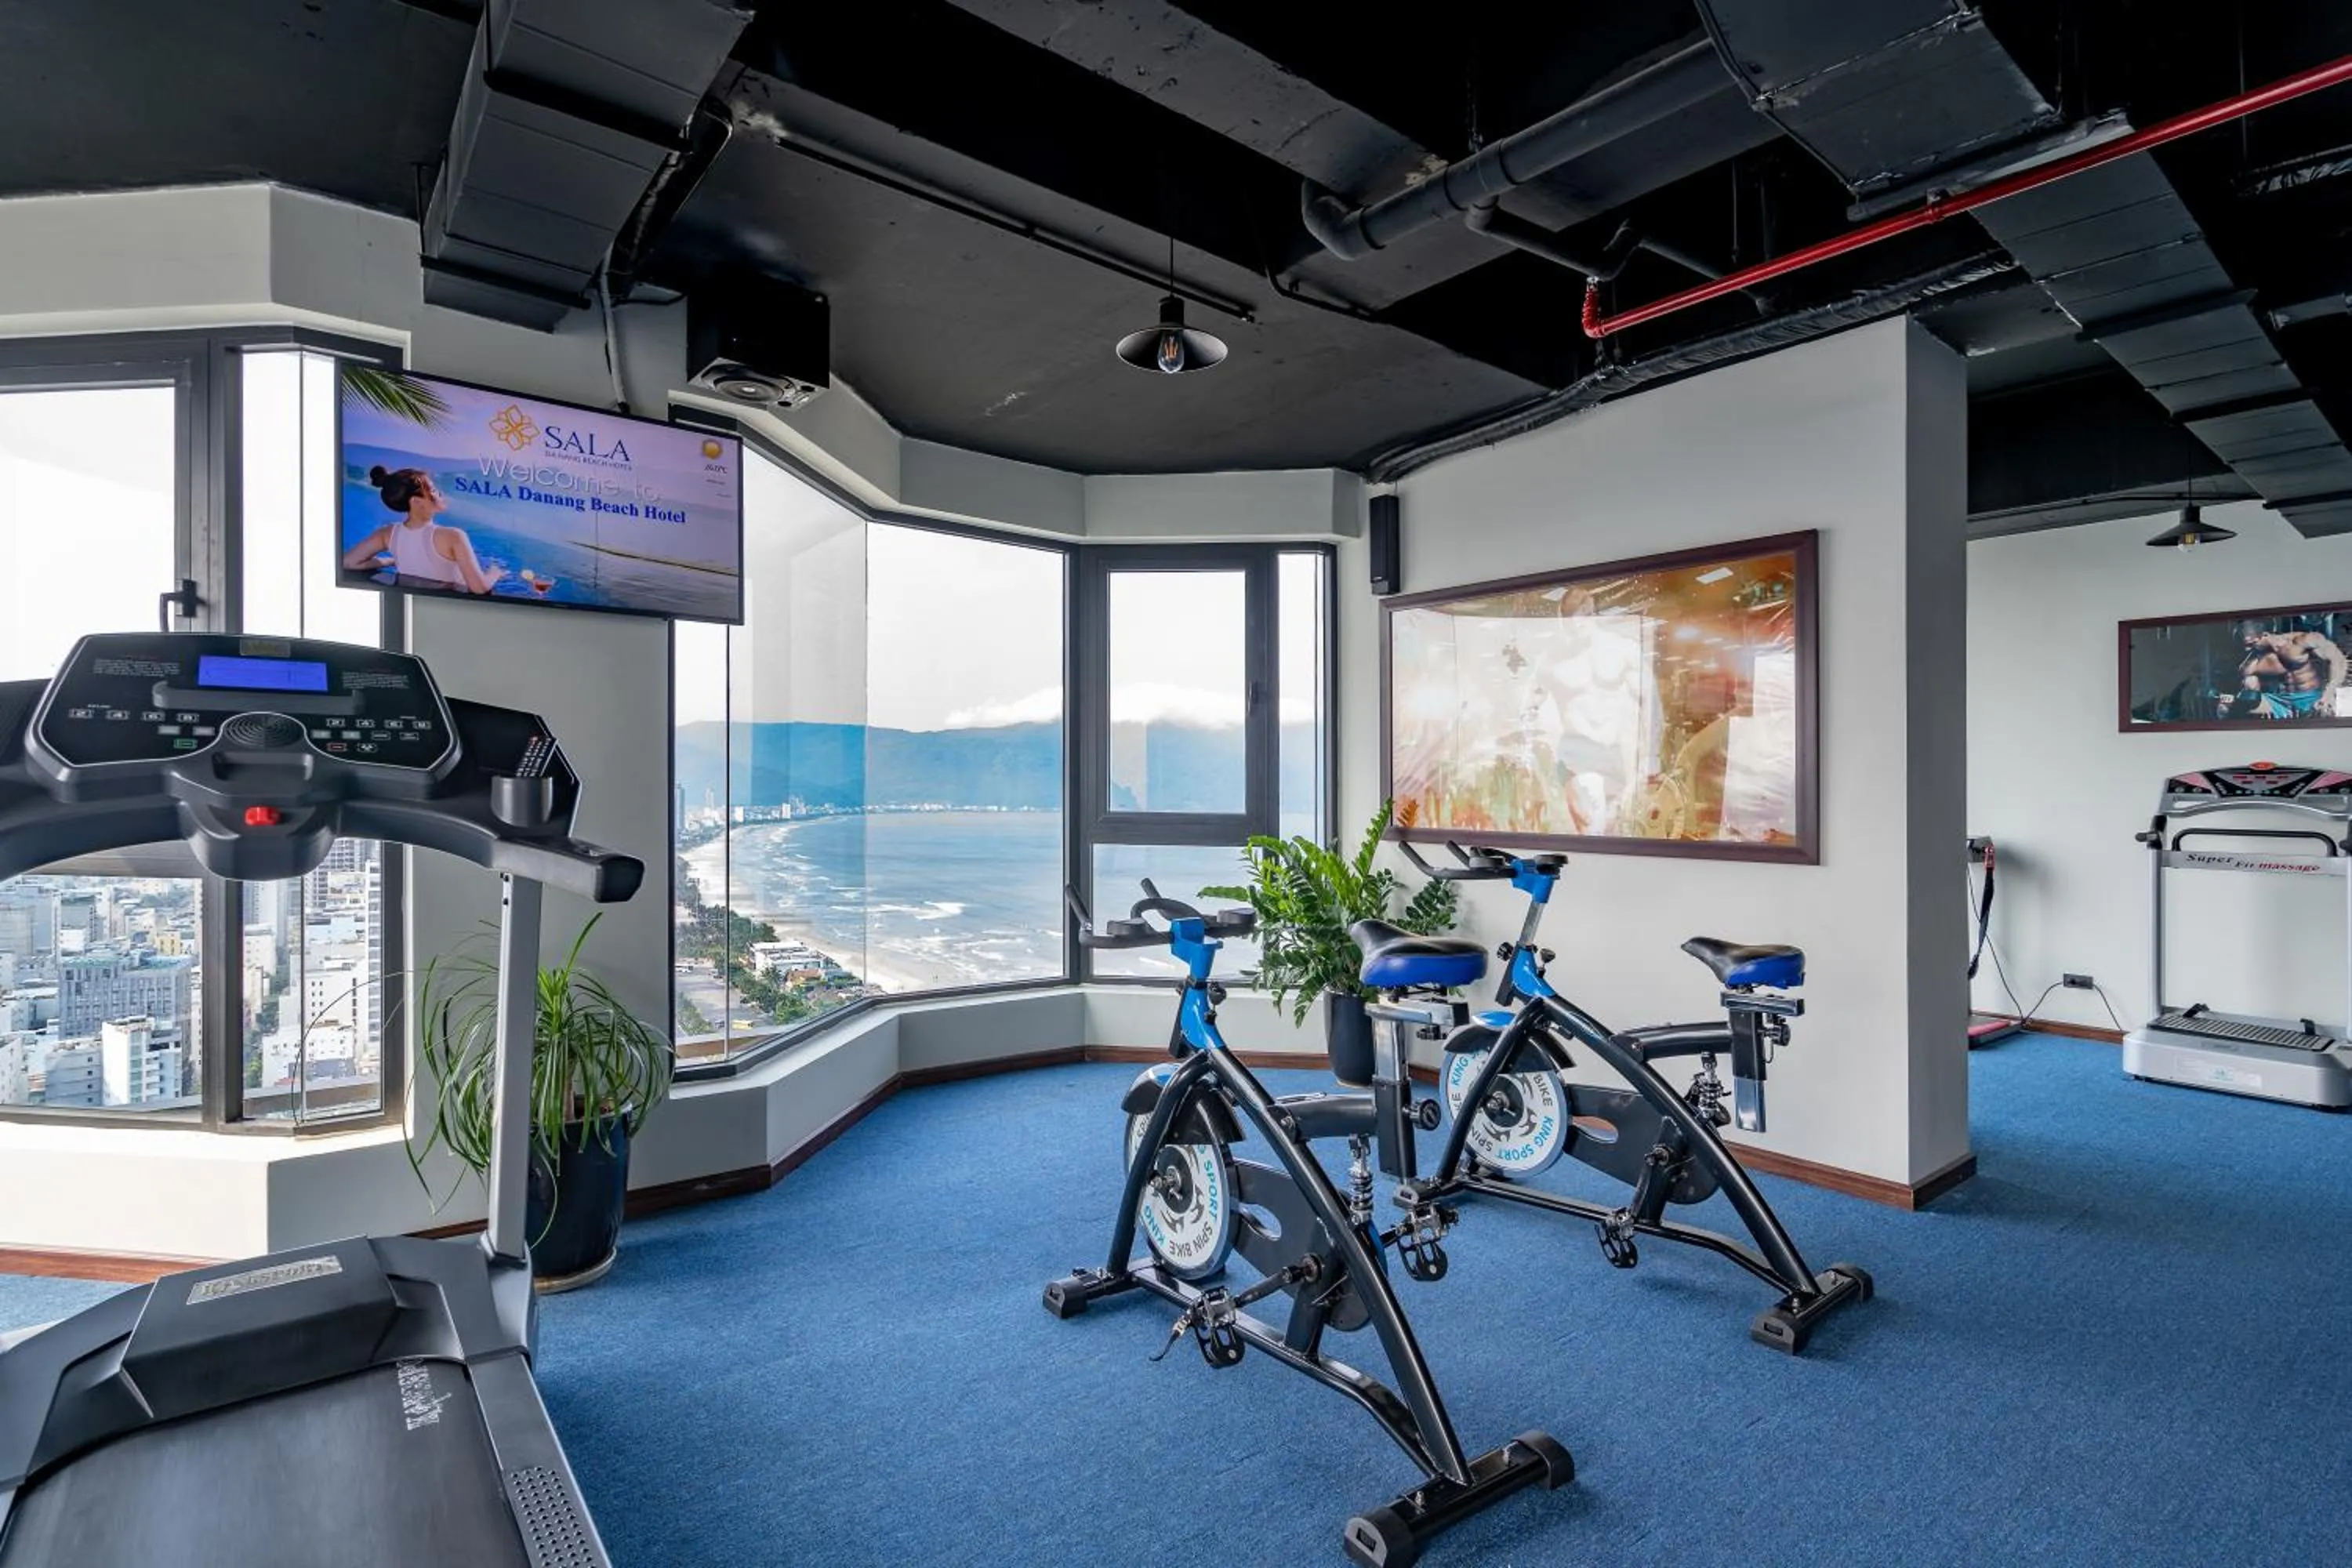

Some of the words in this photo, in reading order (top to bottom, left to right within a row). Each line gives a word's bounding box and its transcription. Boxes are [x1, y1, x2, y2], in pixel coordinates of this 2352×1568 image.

[545, 426, 630, 461] SALA
[477, 454, 621, 496] Welcome
[455, 476, 512, 499] SALA
[517, 485, 586, 511] Danang
[591, 497, 639, 517] Beach
[644, 506, 686, 524] Hotel
[2186, 853, 2234, 864] Super
[2258, 862, 2321, 873] massage
[1451, 1056, 1468, 1086] KING
[1532, 1073, 1554, 1108] BIKE
[1534, 1115, 1555, 1147] KING
[1496, 1143, 1535, 1160] SPORT
[1203, 1160, 1218, 1221] SPORT
[1143, 1205, 1166, 1246] KING
[1192, 1220, 1214, 1255] SPIN
[1168, 1239, 1192, 1258] BIKE
